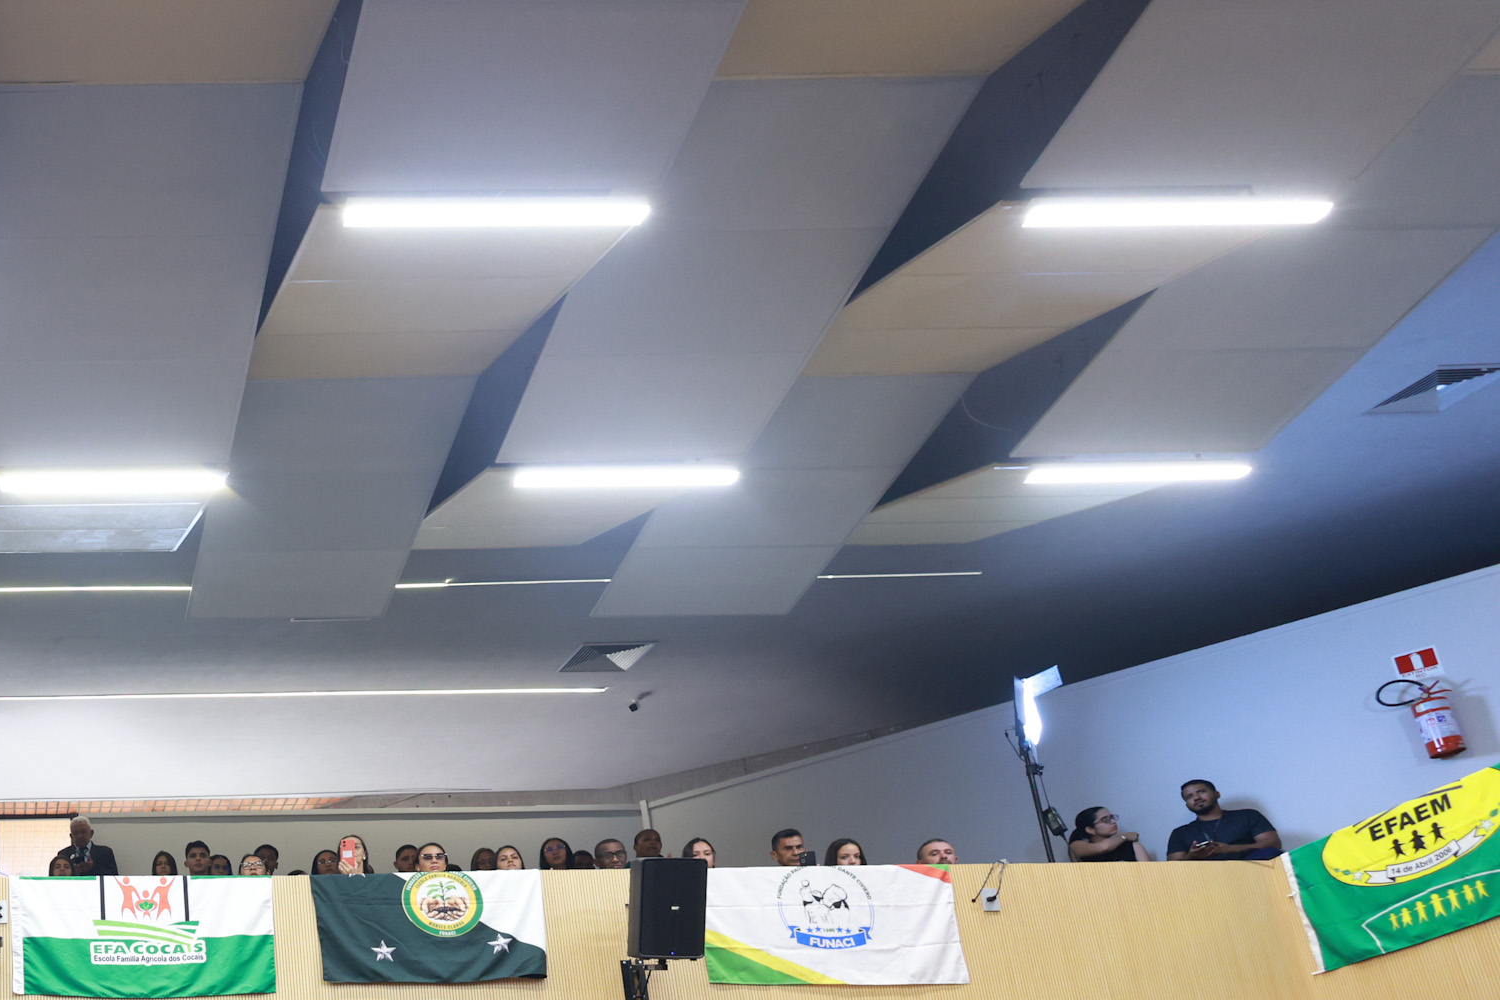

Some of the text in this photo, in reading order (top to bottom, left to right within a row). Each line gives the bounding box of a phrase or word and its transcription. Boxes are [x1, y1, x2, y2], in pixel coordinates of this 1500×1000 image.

[1368, 793, 1452, 842] EFAEM
[1391, 867, 1401, 875] 14
[1403, 865, 1413, 873] de
[1415, 857, 1433, 870] Abril
[776, 872, 792, 899] FUNDAÇÃO
[837, 866, 872, 900] DANTE CIVIERO
[93, 944, 127, 954] EFA
[810, 936, 856, 948] FUNACI
